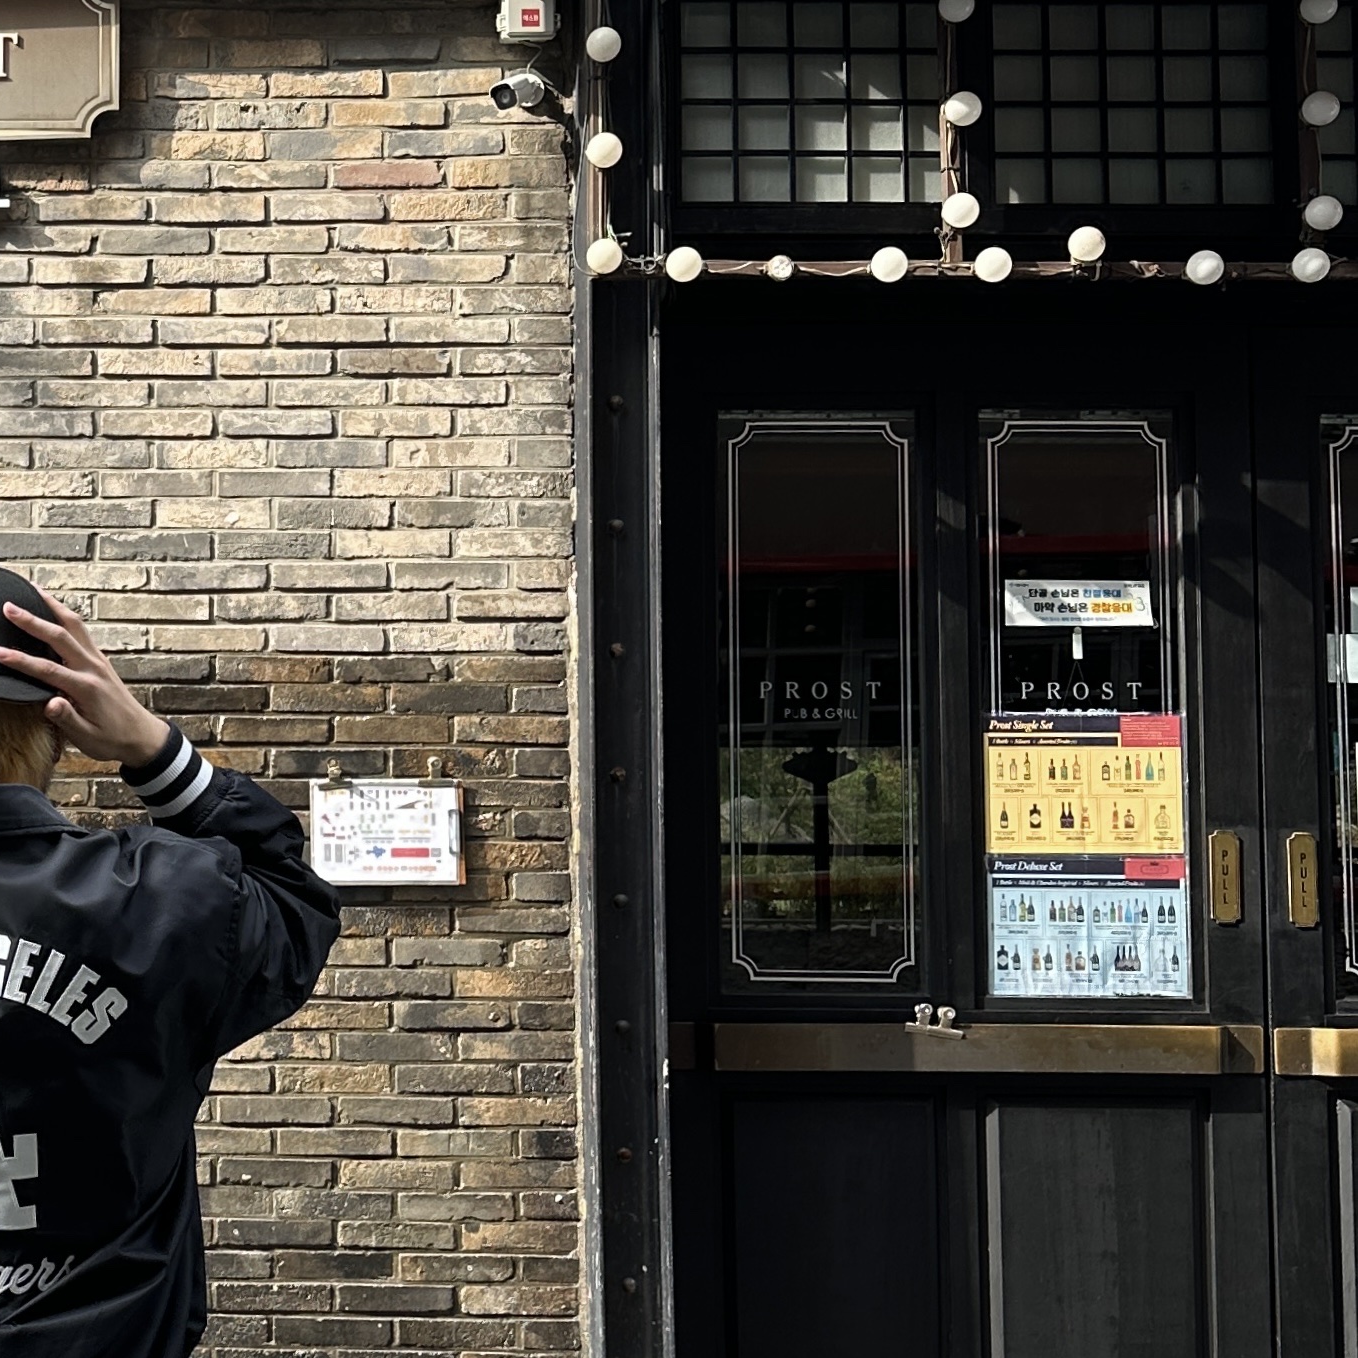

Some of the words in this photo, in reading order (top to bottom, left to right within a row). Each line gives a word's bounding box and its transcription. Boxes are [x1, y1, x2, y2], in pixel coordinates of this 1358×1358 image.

[1028, 588, 1048, 598] 단골
[1050, 588, 1080, 598] 손님은
[1033, 601, 1056, 613] 마약
[1057, 602, 1088, 613] 손님은
[760, 681, 881, 699] PROST
[1021, 681, 1143, 700] PROST
[989, 719, 1013, 730] Prost
[1013, 719, 1040, 733] Single
[1039, 719, 1054, 730] Set
[993, 861, 1017, 871] Prost
[1049, 861, 1063, 871] Set
[1221, 850, 1229, 905] PULL
[1299, 852, 1307, 908] PULL
